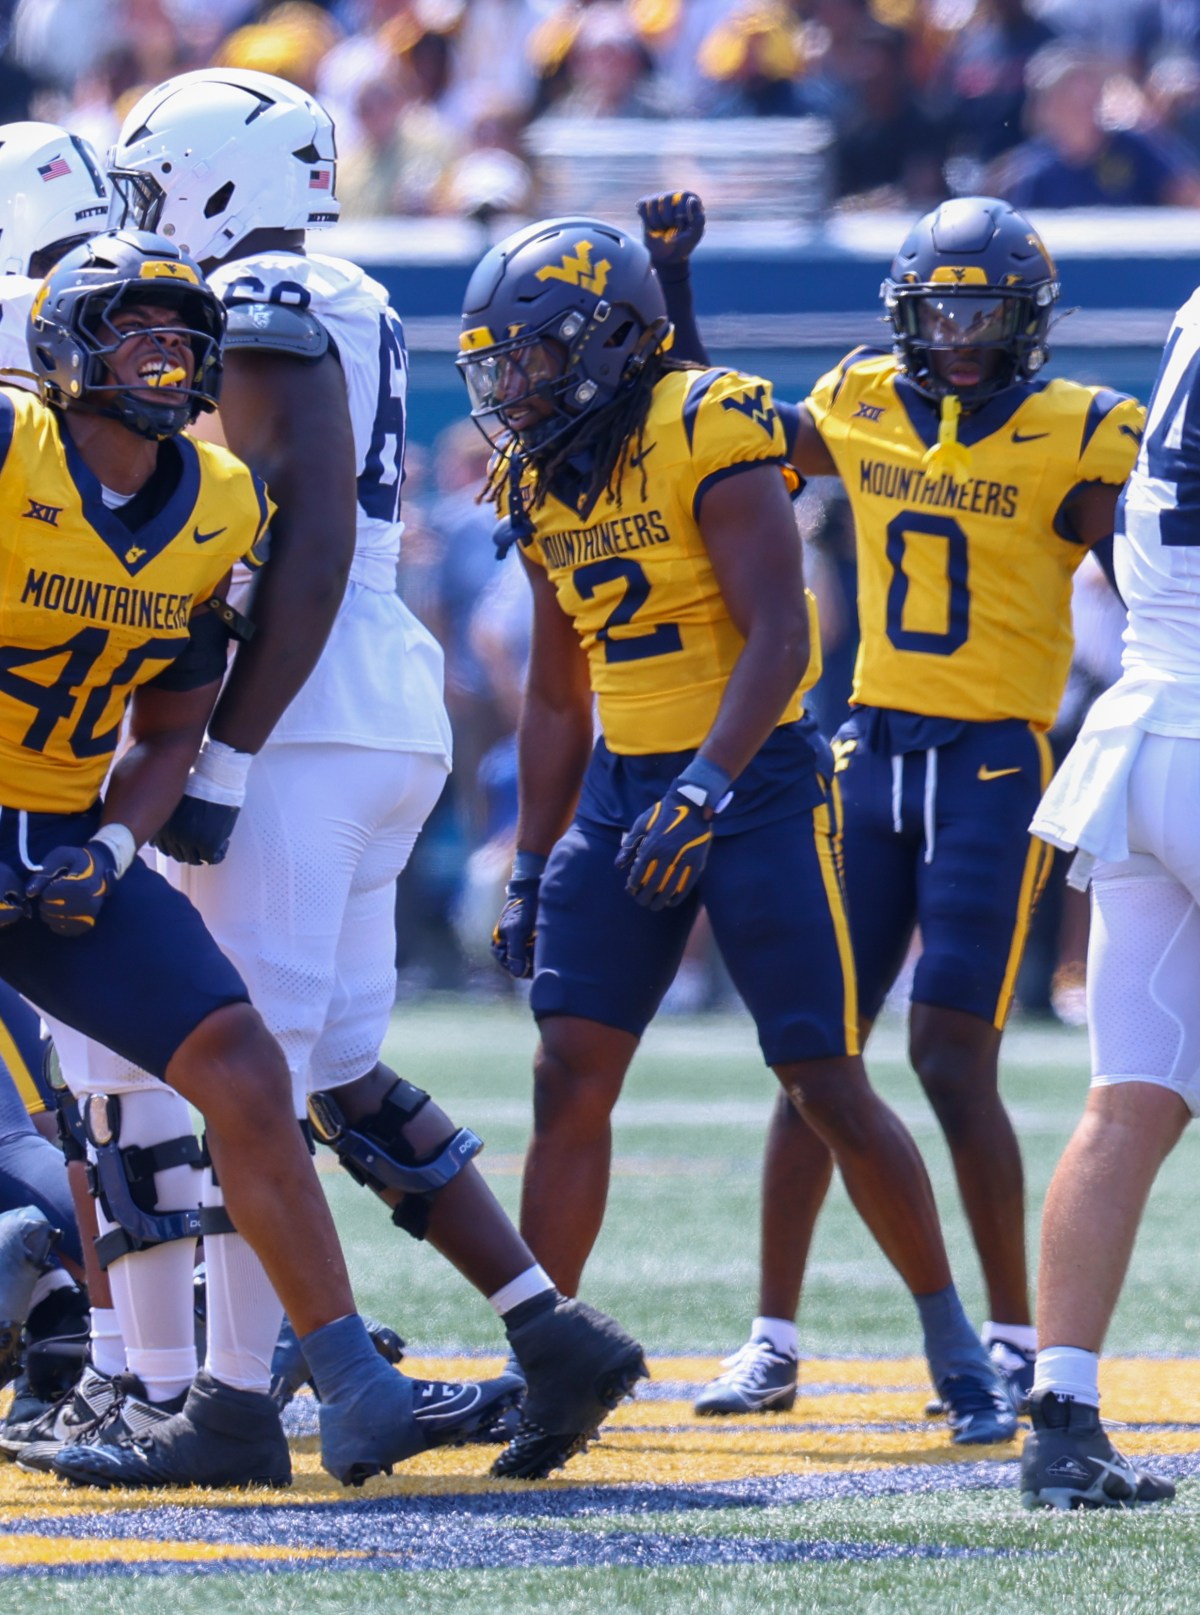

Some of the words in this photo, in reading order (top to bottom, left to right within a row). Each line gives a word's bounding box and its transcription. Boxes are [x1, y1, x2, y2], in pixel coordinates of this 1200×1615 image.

[852, 400, 886, 423] XII
[21, 498, 64, 528] XII
[572, 556, 684, 665] 2
[885, 509, 972, 657] 0
